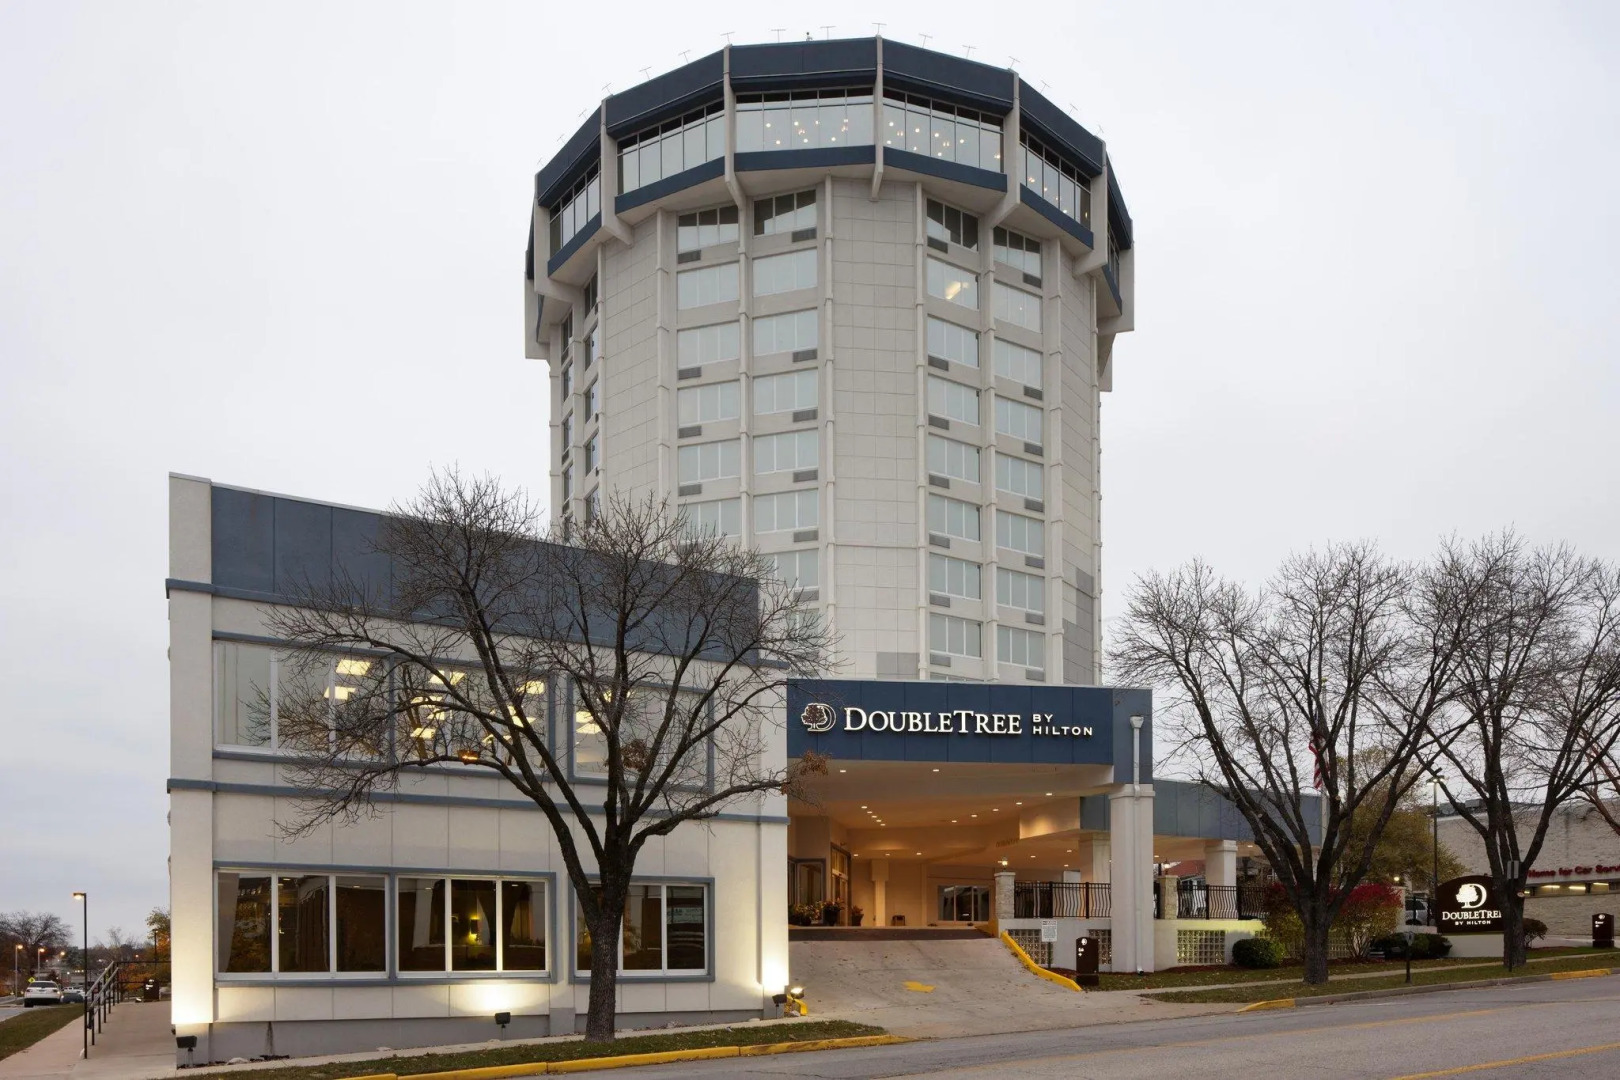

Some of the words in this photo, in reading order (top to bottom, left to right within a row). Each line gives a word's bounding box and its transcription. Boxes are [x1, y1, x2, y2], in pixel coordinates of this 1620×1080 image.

[844, 707, 1023, 734] DOUBLETREE
[1032, 713, 1053, 722] BY
[1032, 725, 1093, 736] HILTON
